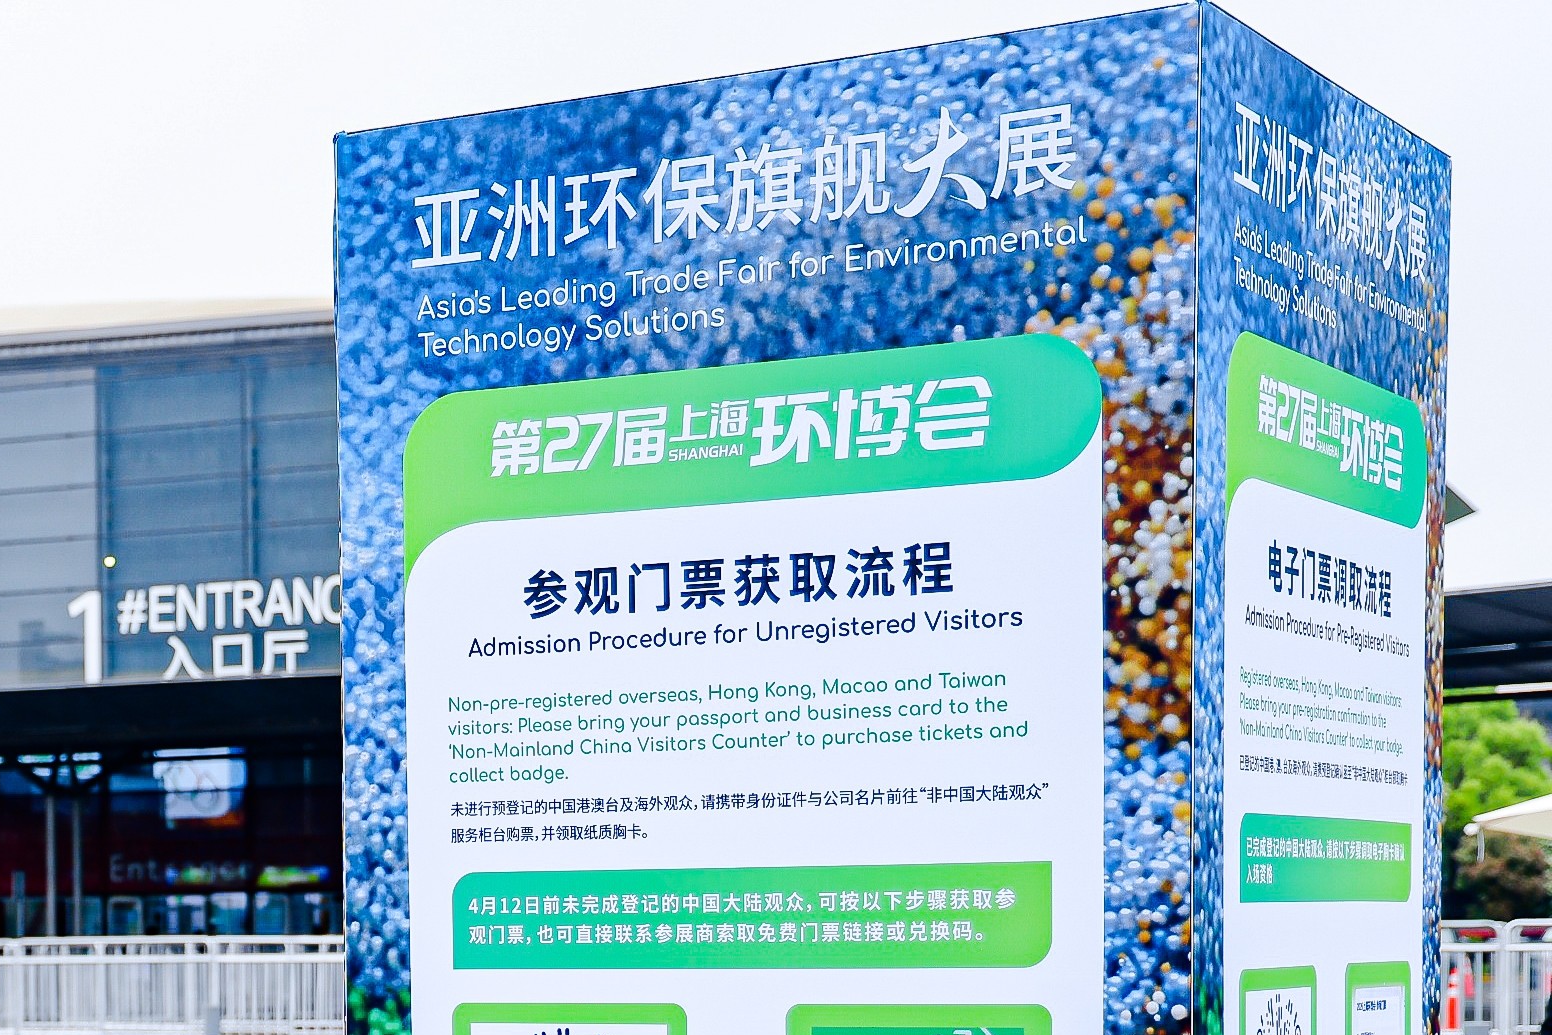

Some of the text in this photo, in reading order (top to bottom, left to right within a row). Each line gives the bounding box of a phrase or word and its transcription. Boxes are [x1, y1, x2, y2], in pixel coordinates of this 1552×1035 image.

[411, 103, 1077, 269] 亚洲环保旗舰大展
[1233, 101, 1428, 284] 亚洲环保旗舰大展
[417, 215, 1088, 321] Asia's Leading Trade Fair for Environmental
[1234, 214, 1427, 333] Asia's Leading Trade Fair for Environmental
[1234, 256, 1337, 329] Technology Solutions
[417, 306, 725, 358] Technology Solutions
[668, 444, 744, 463] SHANGHAI
[523, 541, 954, 619] 参观门票获取流程
[1268, 539, 1392, 618] 电子门票调取流程
[67, 590, 103, 685] 1
[160, 629, 309, 681] 入口厅
[468, 609, 1023, 657] Admission Procedure for Unregistered Visitors
[1245, 604, 1410, 658] Admission Procedure for Pre-Registered Visitors
[448, 672, 1006, 714] Non-pre-registered overseas, Hong Kong, Macao and Taiwan
[448, 696, 1008, 736] visitors: Please bring your passport and business card to the
[580, 737, 632, 755] China
[637, 735, 706, 753] Visitors
[796, 731, 815, 747] to
[821, 727, 913, 749] purchase
[918, 724, 983, 741] tickets
[989, 721, 1028, 738] and
[449, 765, 569, 784] collect badge.
[450, 823, 648, 844] 服务柜台购票，并领取纸质胸卡。
[1246, 864, 1274, 884] 入场资格
[468, 888, 1016, 916] 4月12日前未完成登记的中国大陆观众，可按以下步骤获取参
[468, 920, 984, 945] 观门票，也可直接联系参展商索取免费门票链接或兑换码。
